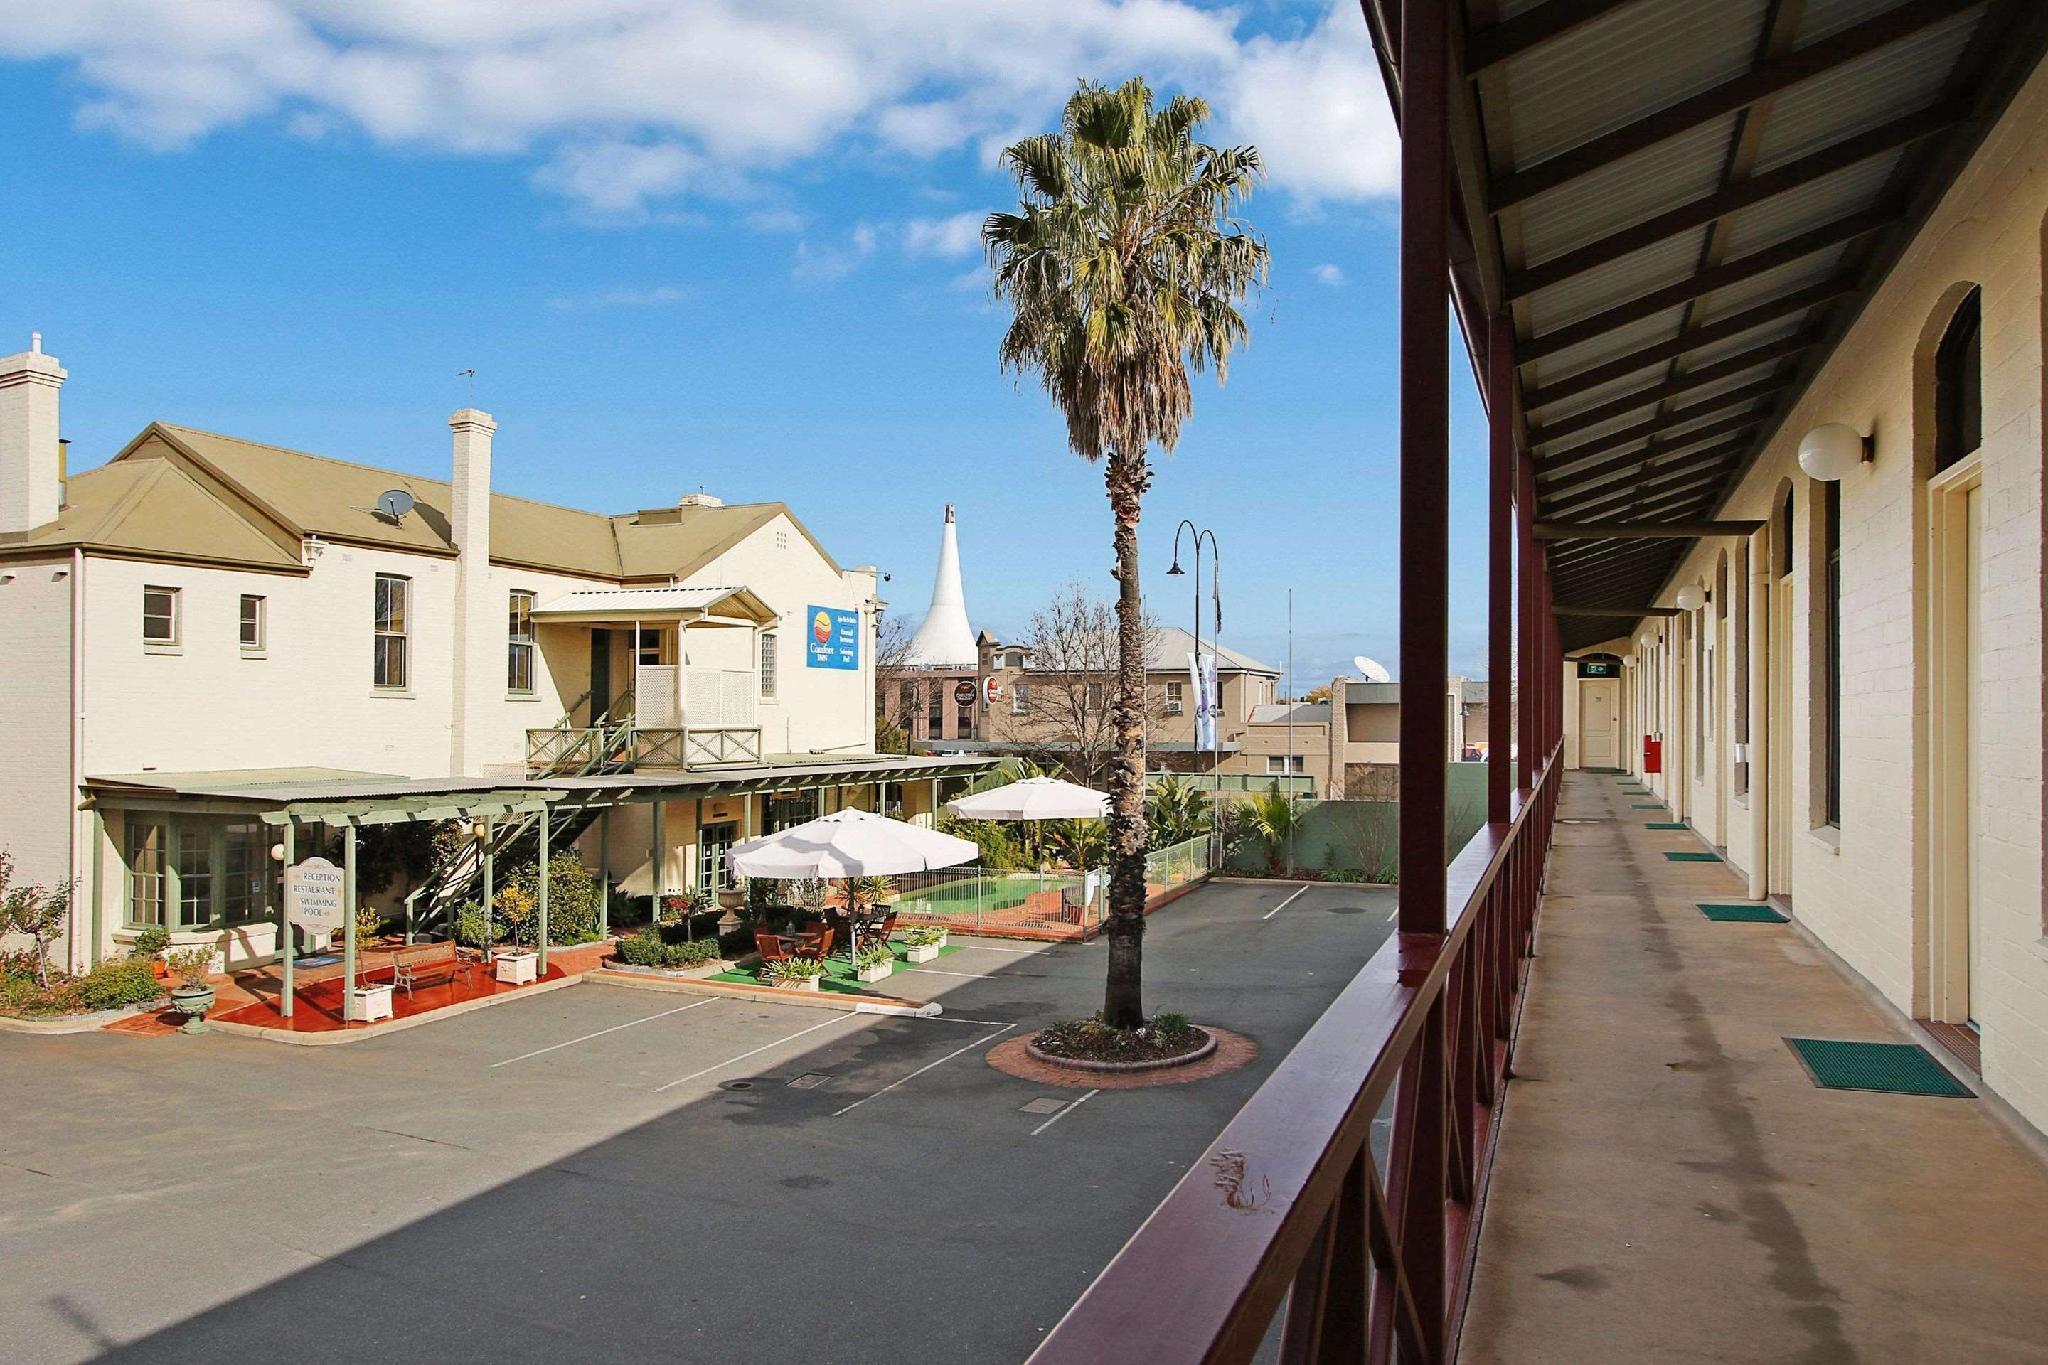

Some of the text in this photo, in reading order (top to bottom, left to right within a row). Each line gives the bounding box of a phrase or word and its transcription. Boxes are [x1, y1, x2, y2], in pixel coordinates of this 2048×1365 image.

[303, 872, 341, 882] RECEPTION
[293, 884, 336, 895] RESTAURANT
[303, 908, 322, 917] POOL
